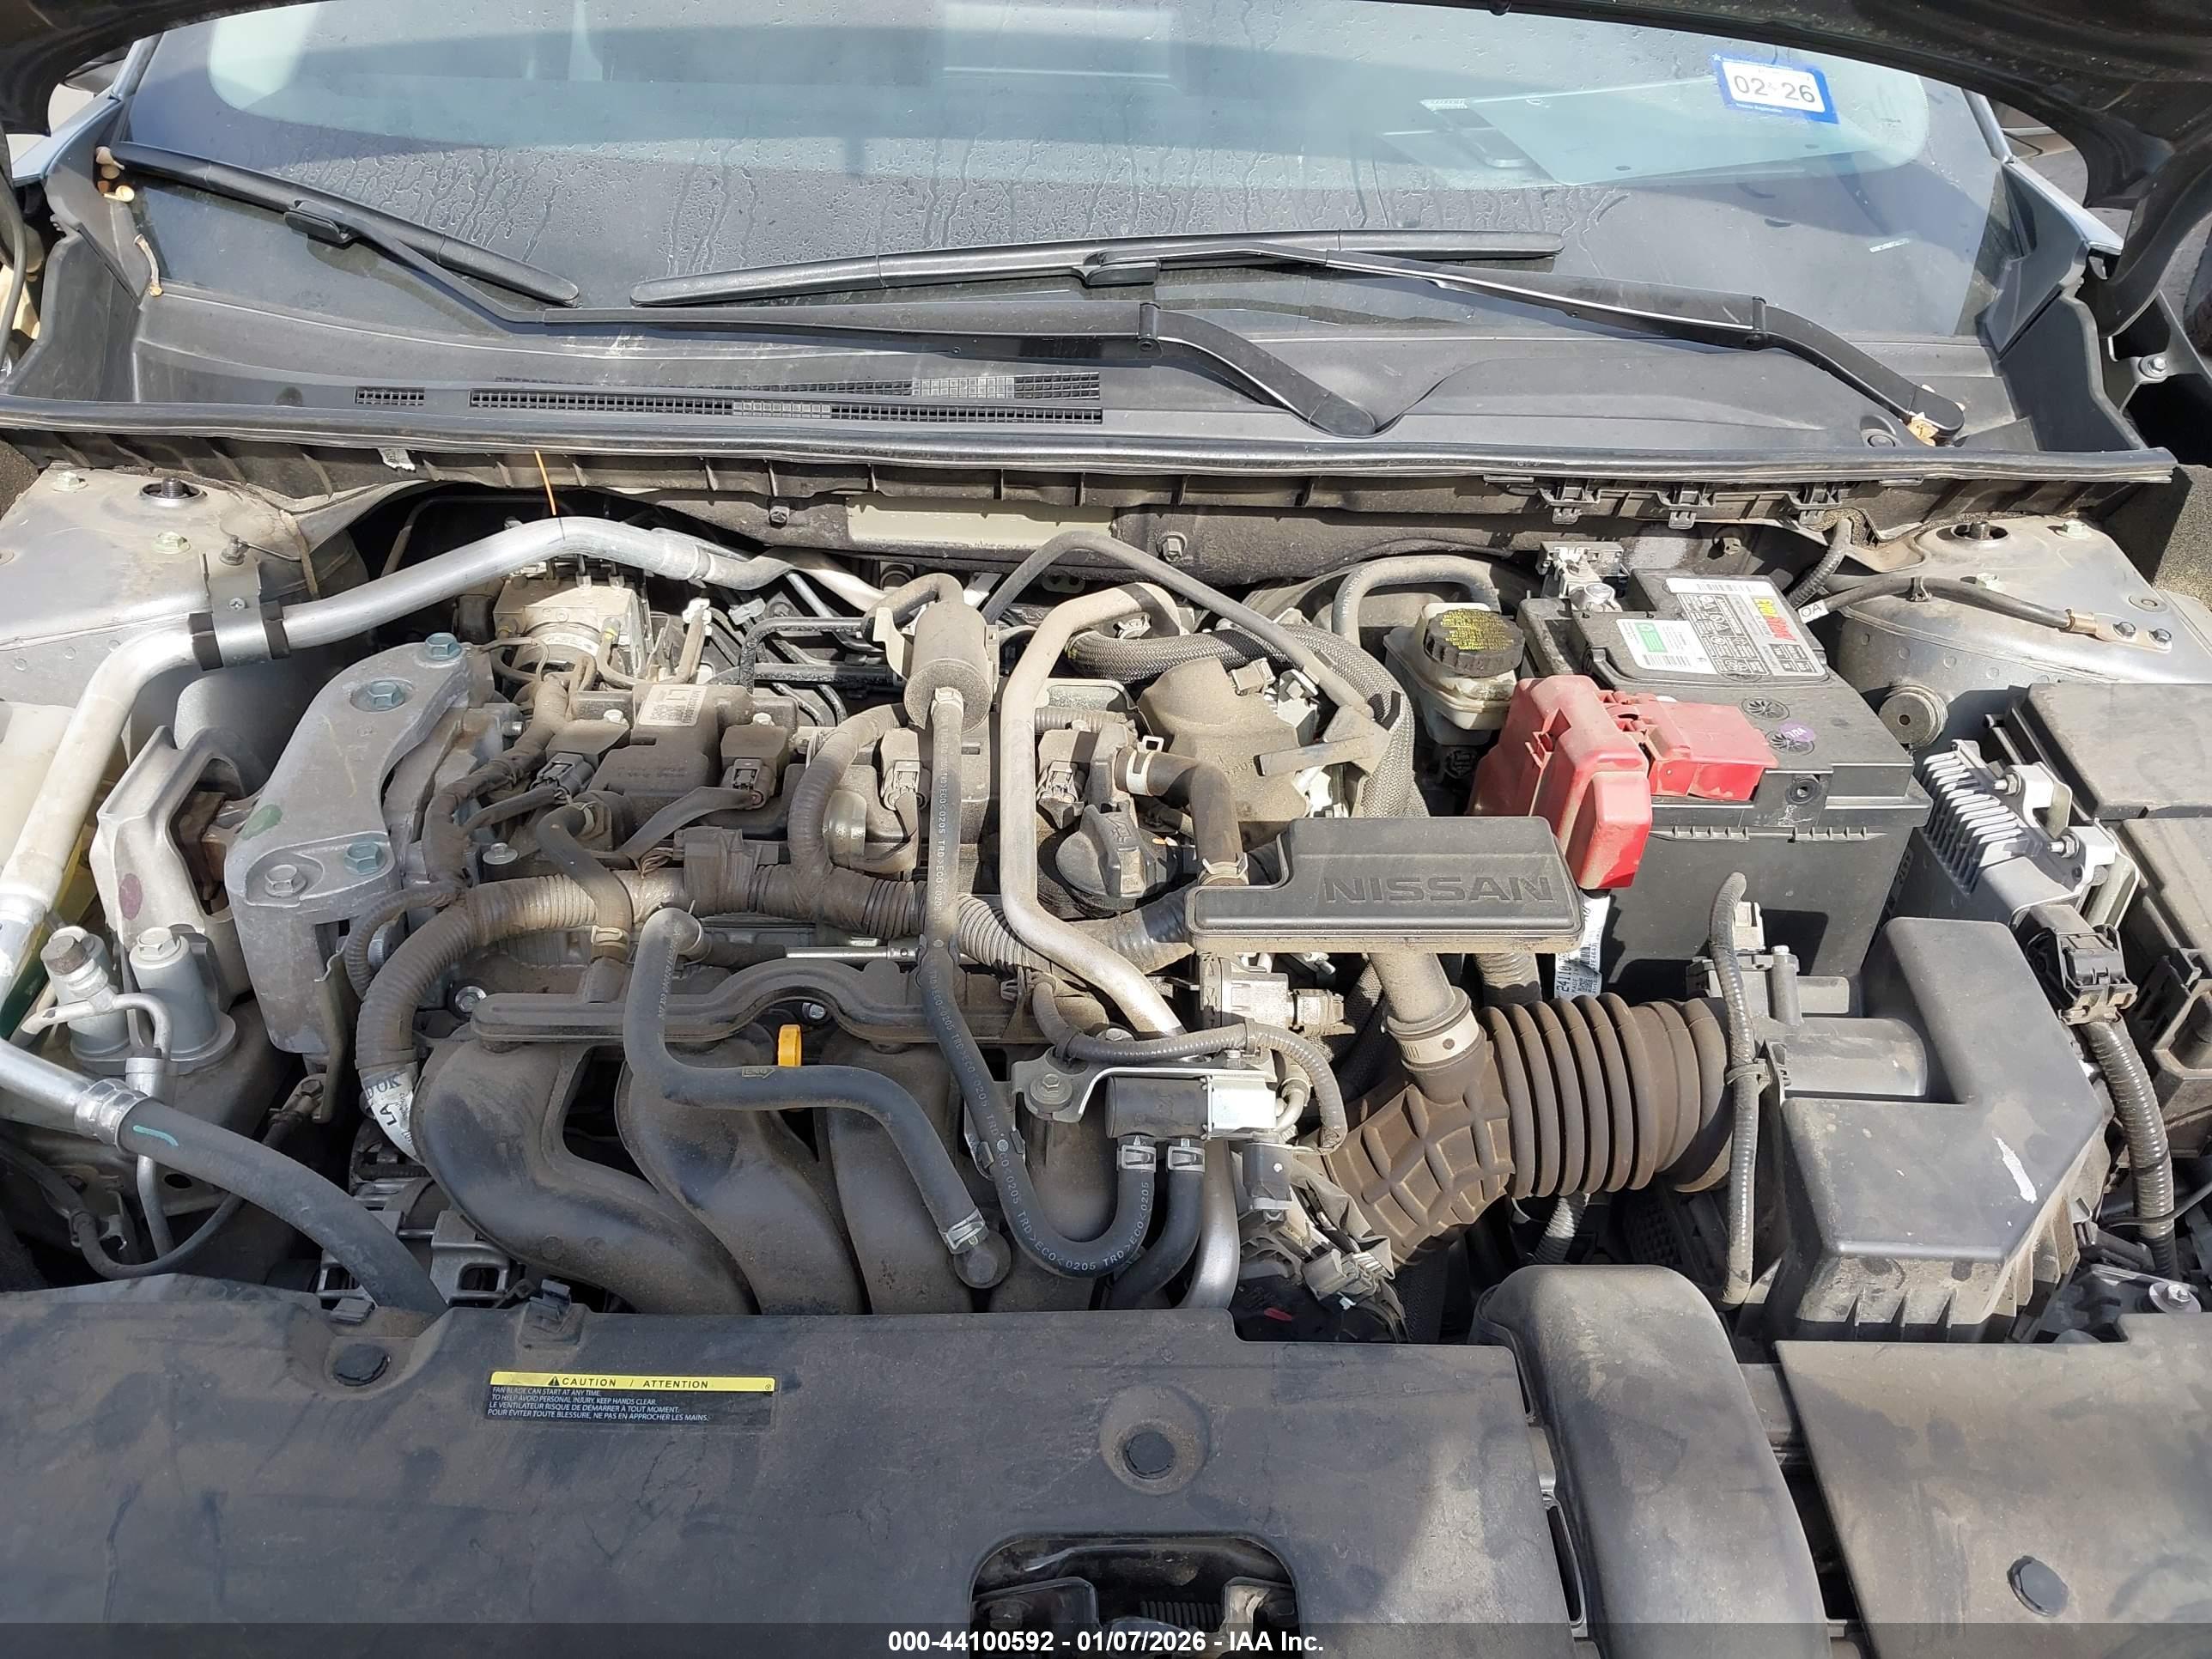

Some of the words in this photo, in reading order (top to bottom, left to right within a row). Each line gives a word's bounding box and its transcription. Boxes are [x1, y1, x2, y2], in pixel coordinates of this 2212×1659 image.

[1734, 75, 1768, 96] 02
[1782, 82, 1815, 103] 26
[1323, 876, 1553, 902] NISSAN
[562, 1377, 617, 1387] CAUTION
[643, 1380, 708, 1389] ATTENTION
[583, 1403, 620, 1412] DÉMARRER
